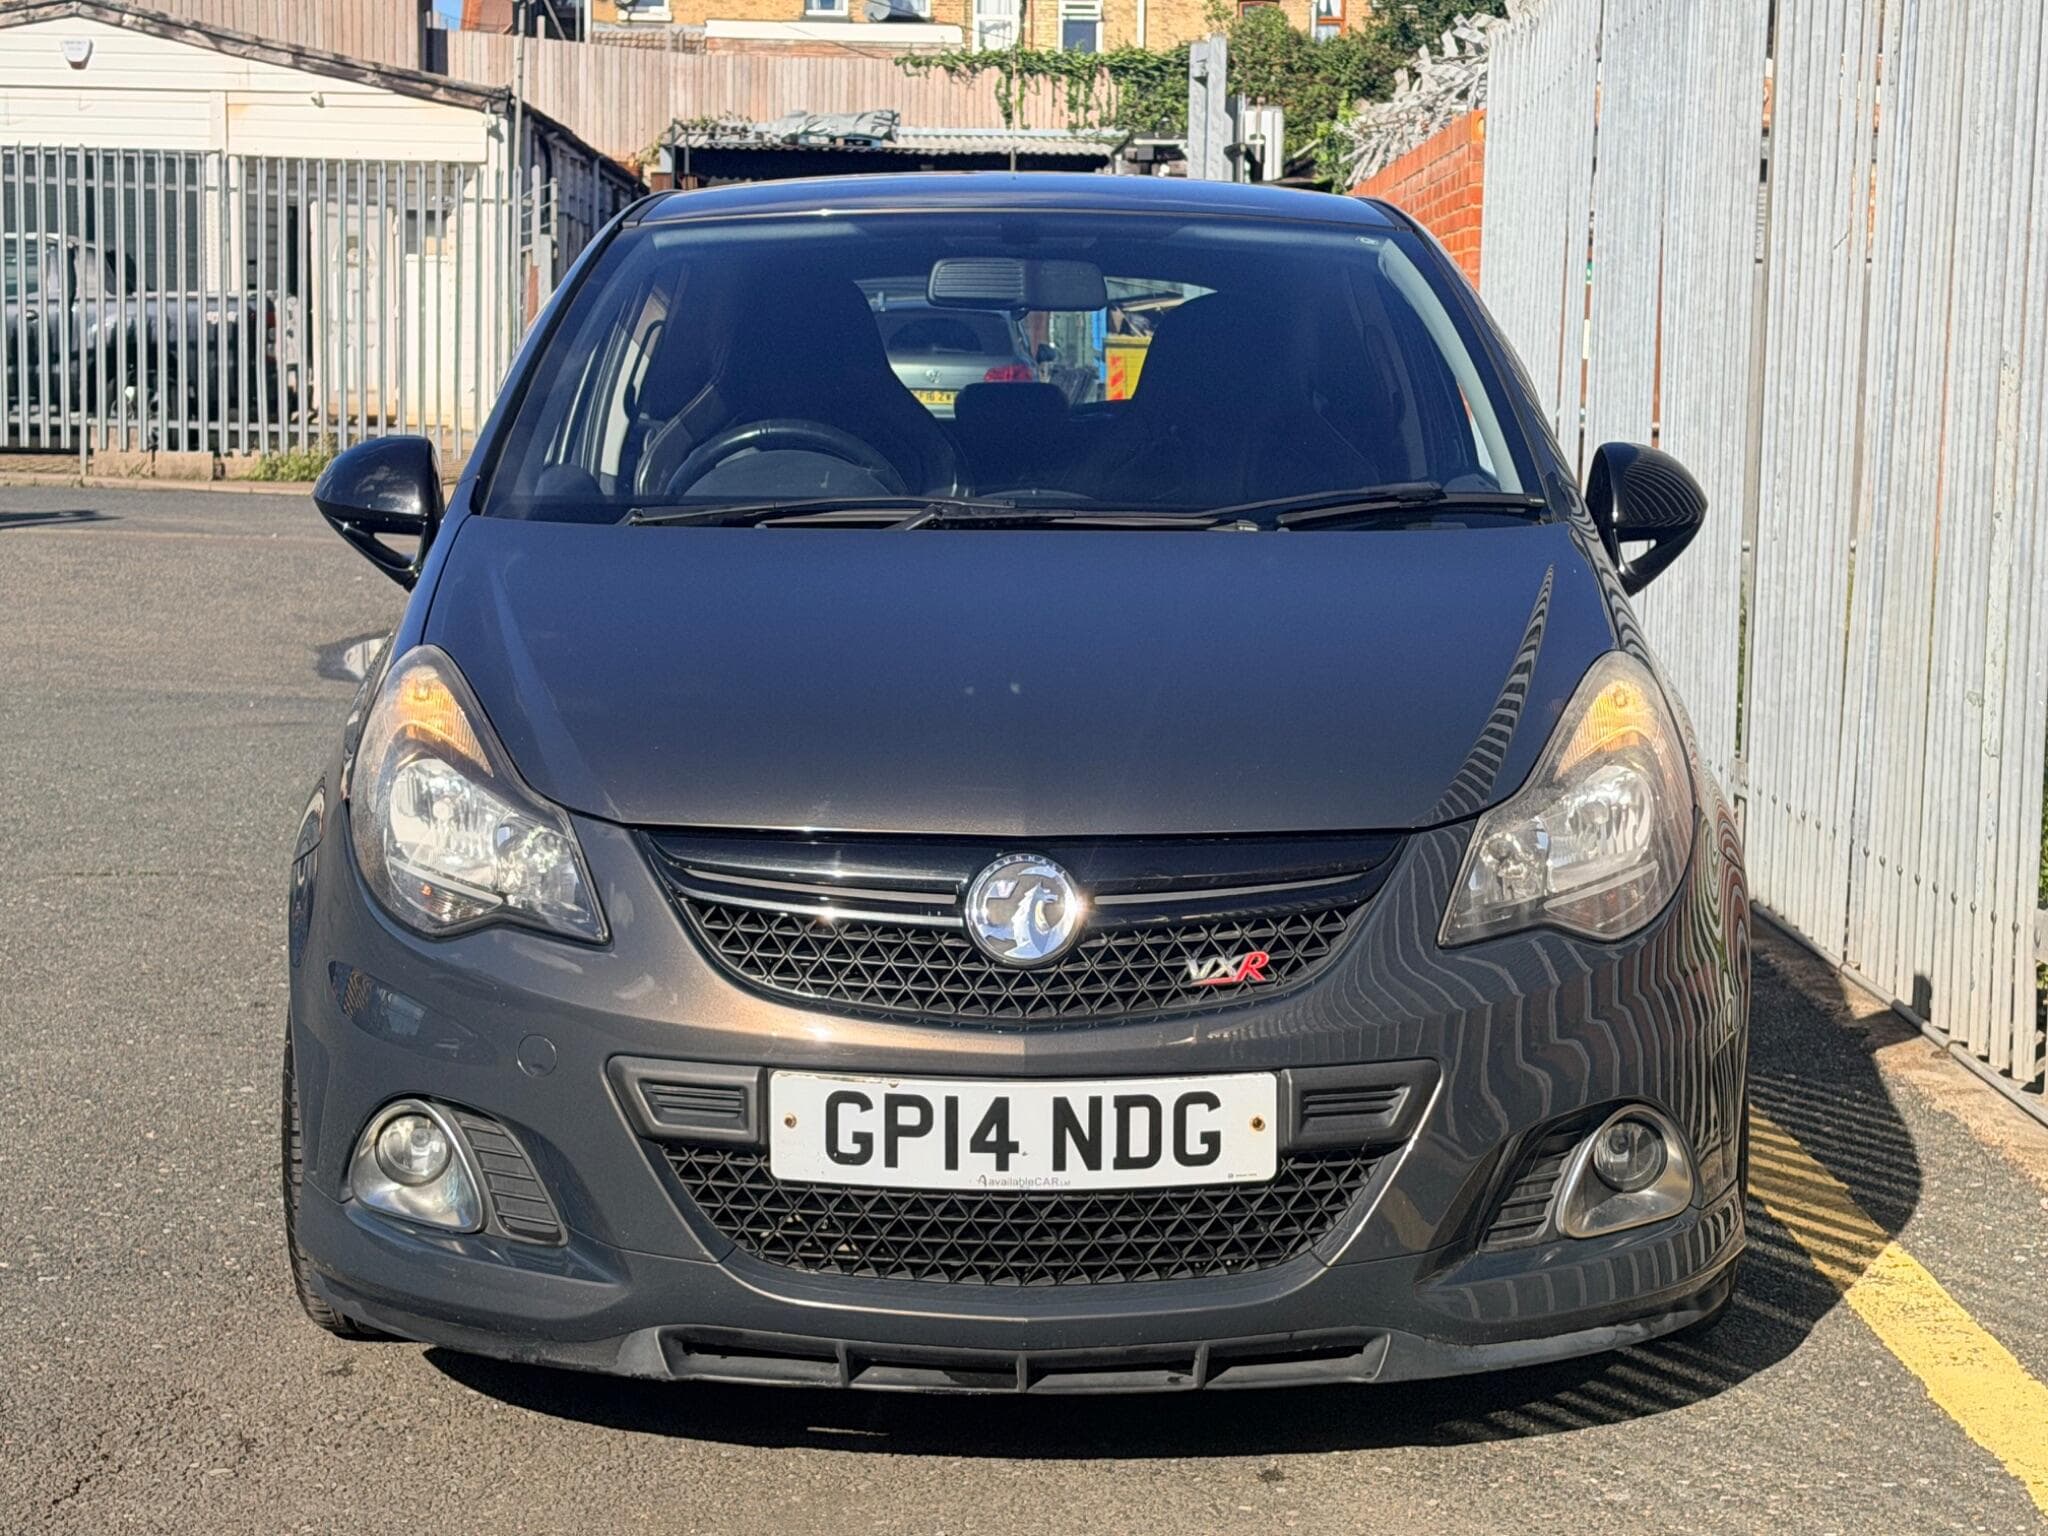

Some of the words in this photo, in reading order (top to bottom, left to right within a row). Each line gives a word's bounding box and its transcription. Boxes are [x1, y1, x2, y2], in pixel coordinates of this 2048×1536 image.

[1185, 951, 1269, 983] VXR
[825, 1090, 1020, 1172] GP14
[1052, 1091, 1222, 1172] NDG
